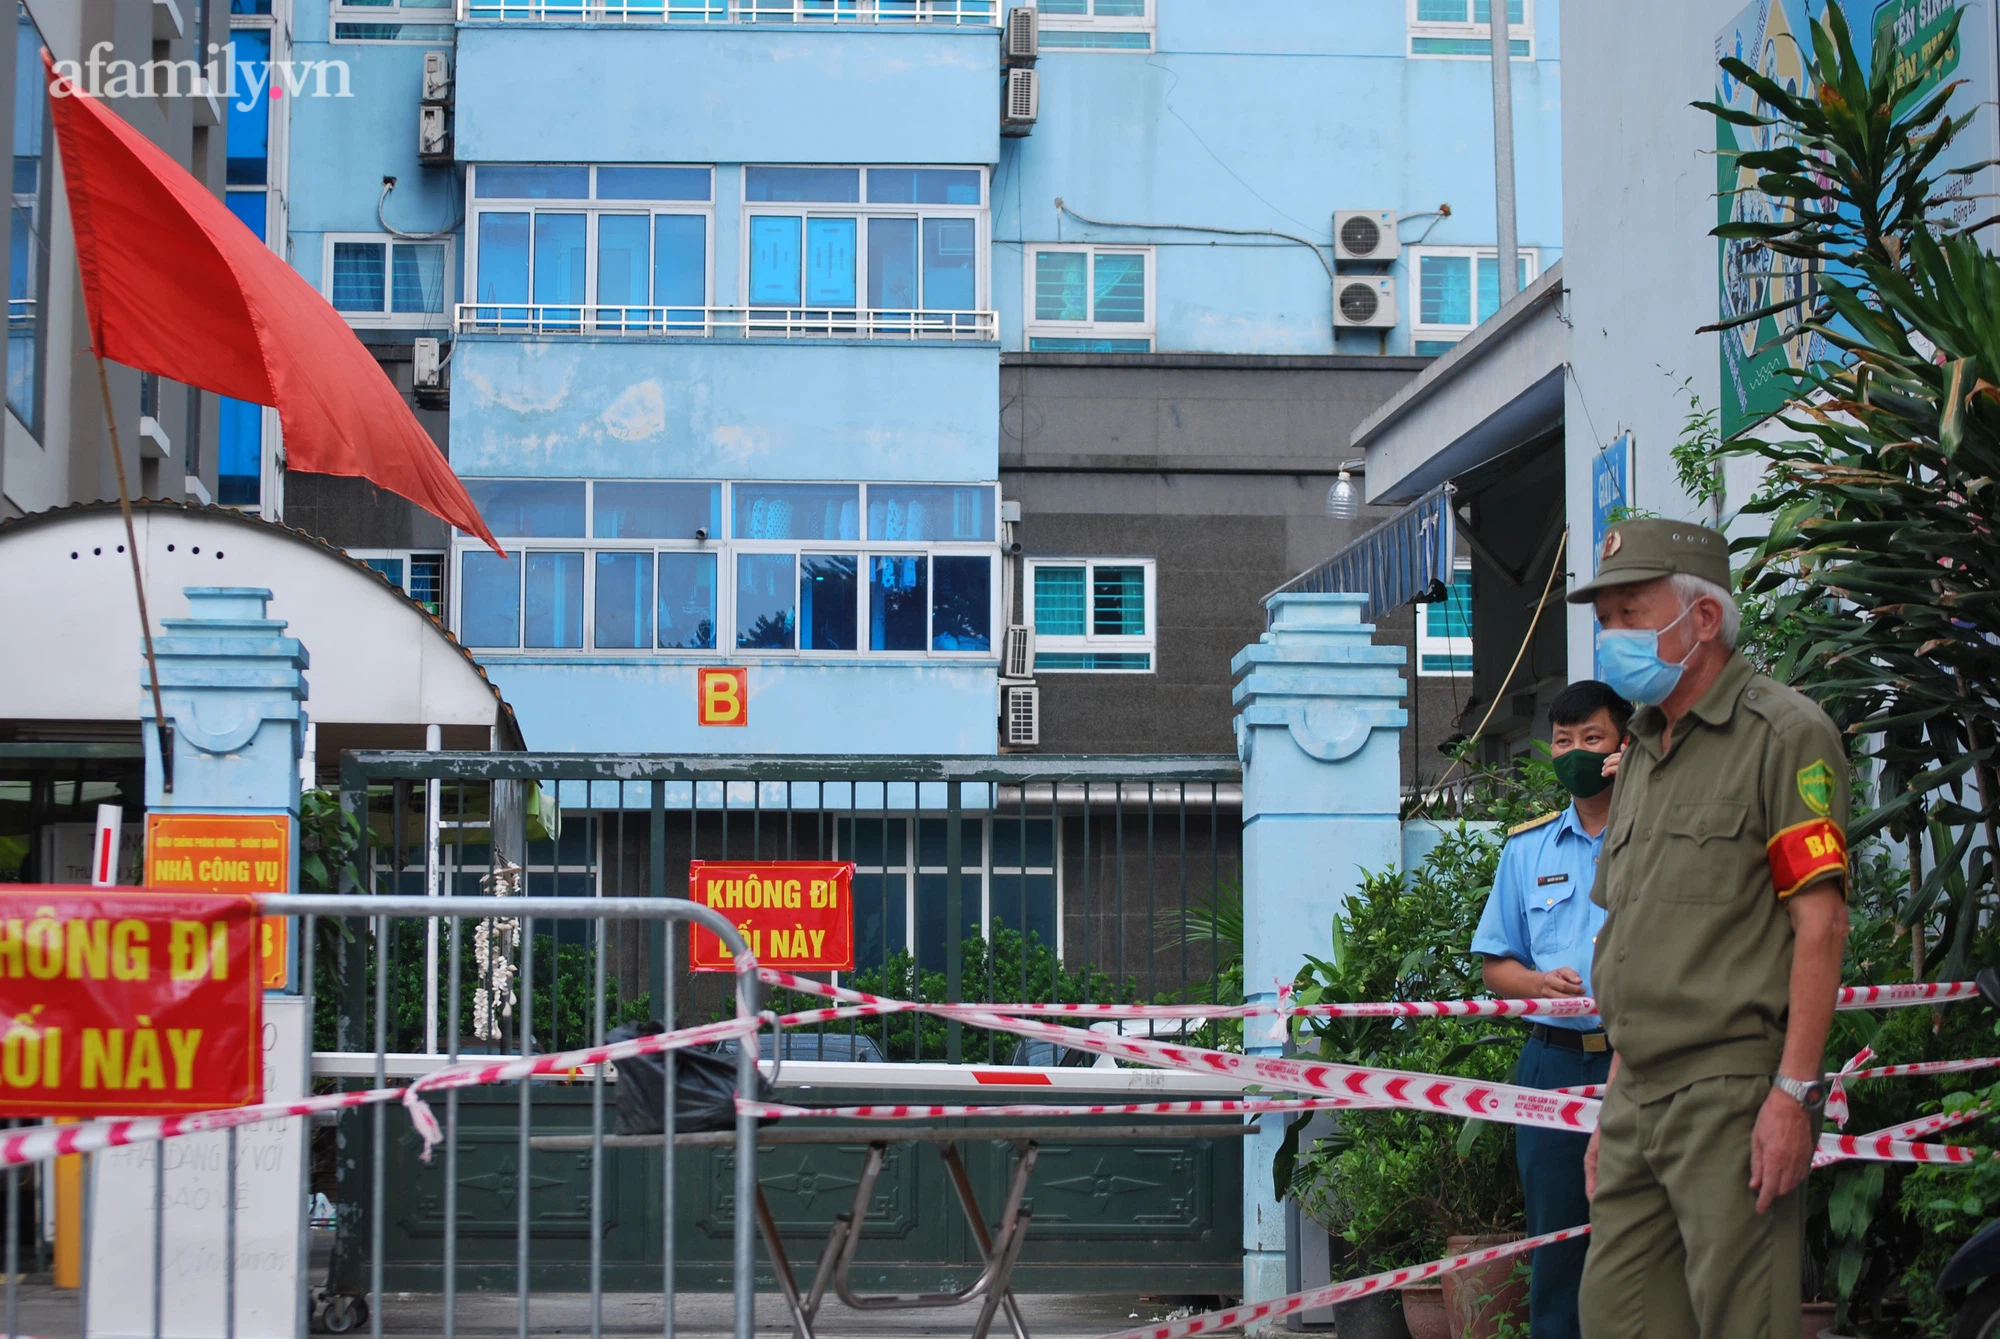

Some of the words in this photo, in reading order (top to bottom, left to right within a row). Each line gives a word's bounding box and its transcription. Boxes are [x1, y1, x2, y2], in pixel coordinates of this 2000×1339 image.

[704, 672, 740, 722] B
[155, 856, 194, 881] NHÀ
[199, 856, 250, 882] CÔNG
[254, 861, 279, 887] VỤ
[707, 873, 801, 909] KHÔNG
[809, 879, 837, 909] ĐI
[168, 920, 229, 981] ĐI
[770, 923, 826, 958] NÀY
[0, 1003, 62, 1089] ỐI
[81, 1014, 203, 1090] NÀY
